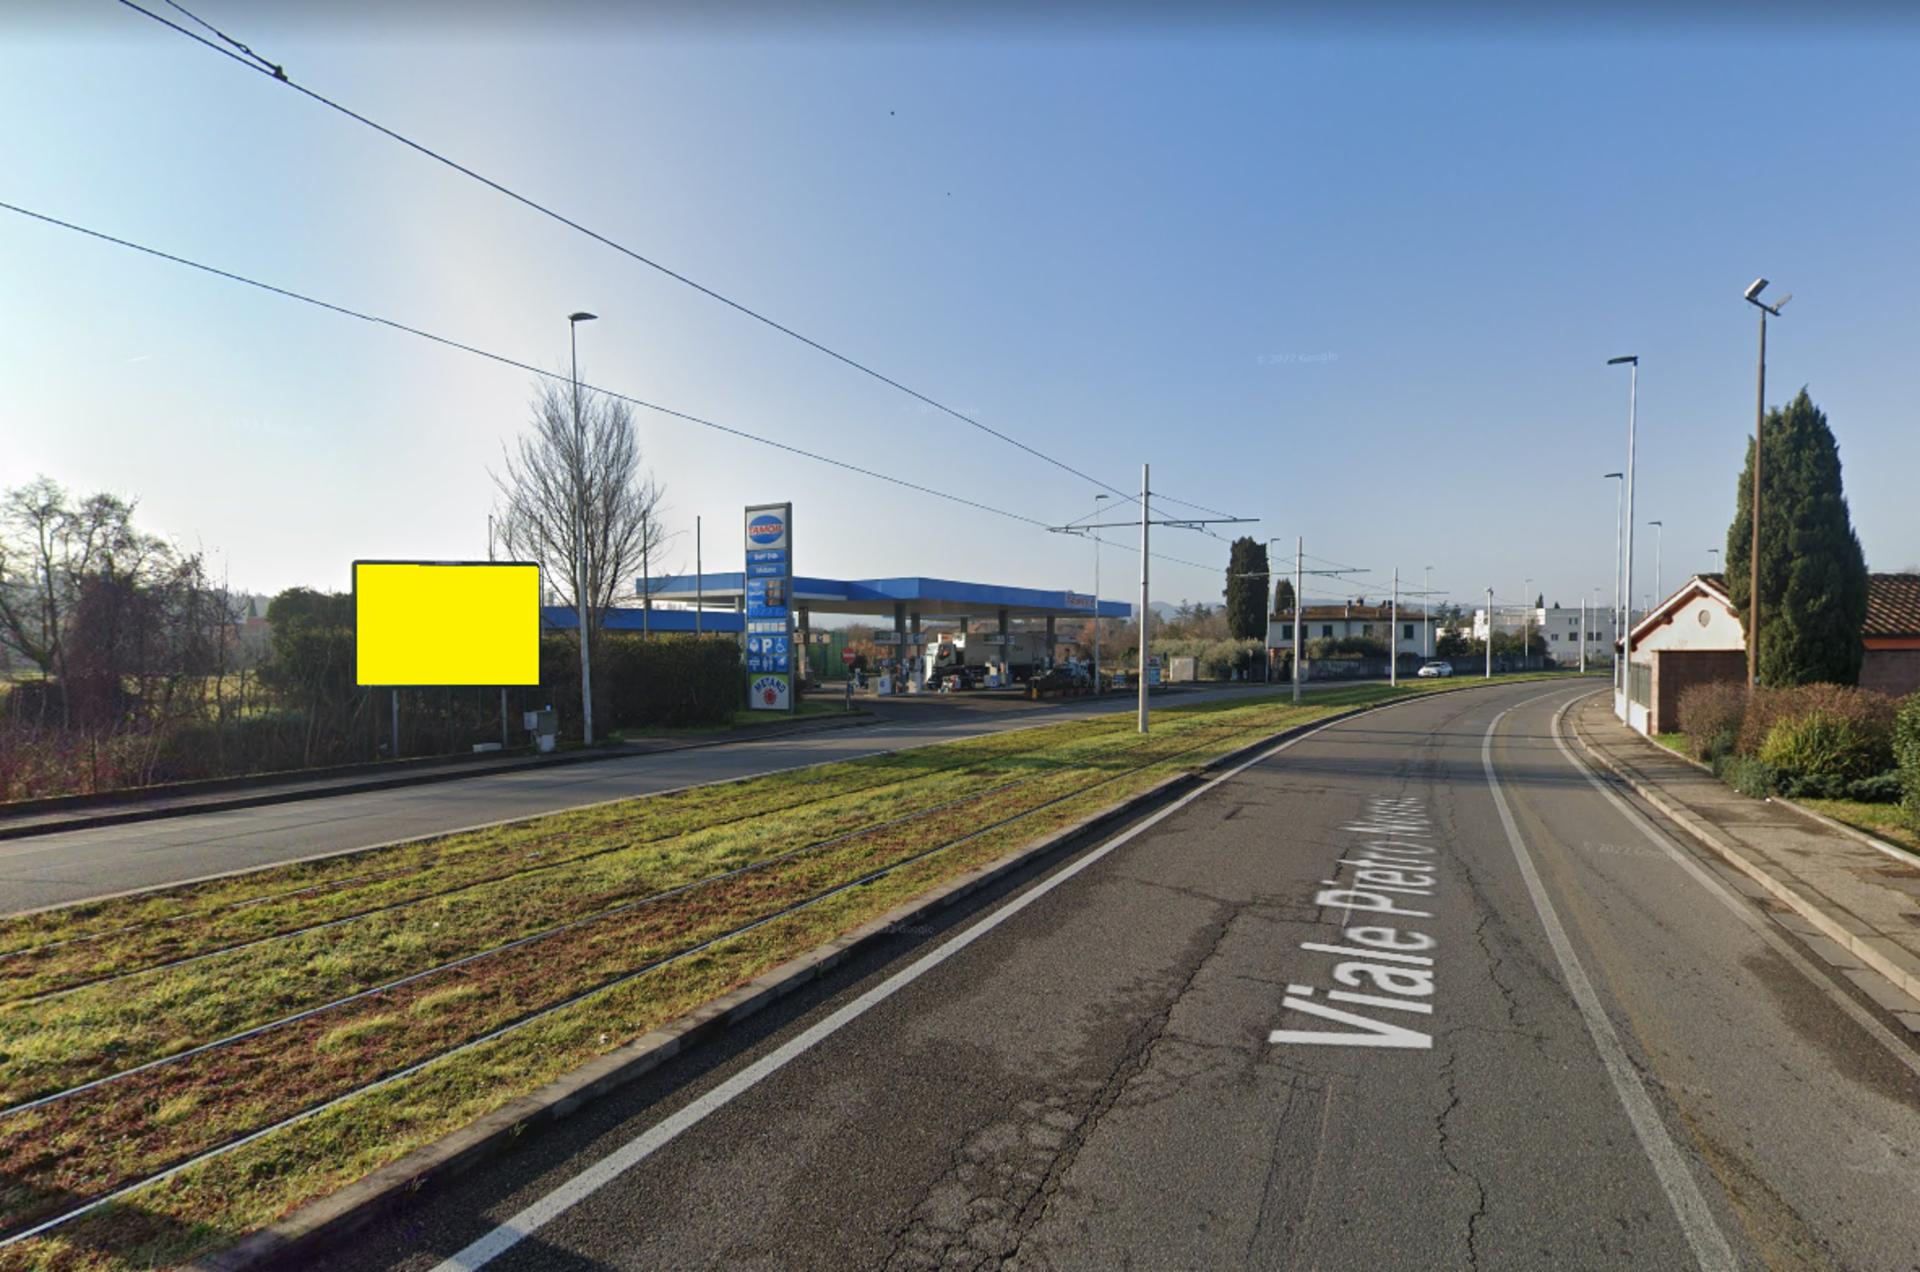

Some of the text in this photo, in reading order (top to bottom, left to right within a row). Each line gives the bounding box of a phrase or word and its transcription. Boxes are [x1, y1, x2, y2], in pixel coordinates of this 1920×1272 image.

[747, 523, 784, 536] TAMOIL
[761, 638, 773, 653] P
[754, 676, 786, 693] METANO
